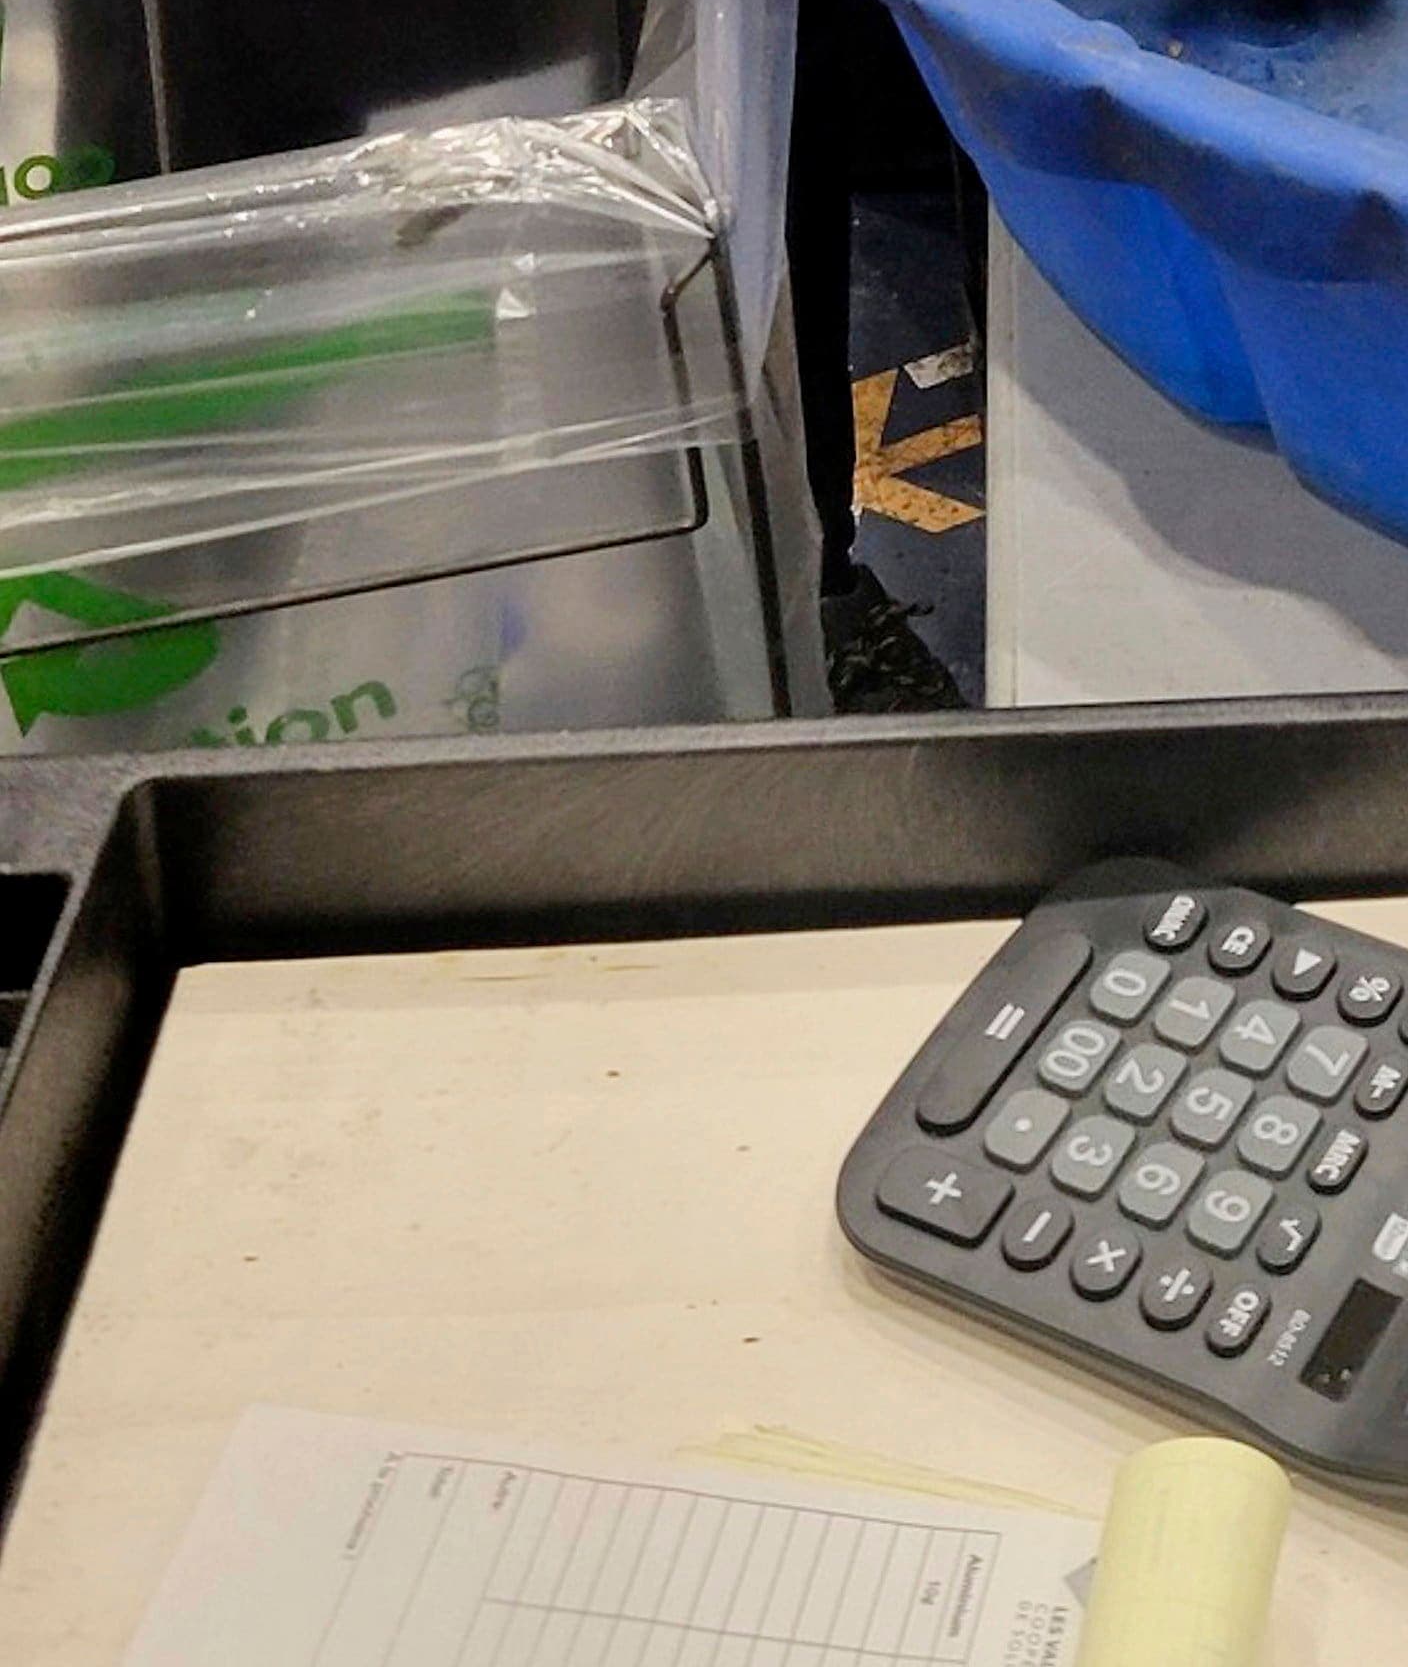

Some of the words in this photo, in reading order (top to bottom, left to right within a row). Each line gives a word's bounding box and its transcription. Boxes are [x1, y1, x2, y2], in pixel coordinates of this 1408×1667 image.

[1101, 967, 1147, 998] 0
[1347, 972, 1391, 1003] %
[1167, 997, 1212, 1021] 1
[1234, 1013, 1277, 1047] 4
[1045, 1026, 1104, 1078] 00
[1305, 1042, 1351, 1077] 7
[1115, 1057, 1165, 1094] 2
[1186, 1086, 1234, 1121] 5
[1252, 1114, 1299, 1146] 8
[1067, 1134, 1113, 1167] 3
[1219, 1290, 1260, 1338] OFF
